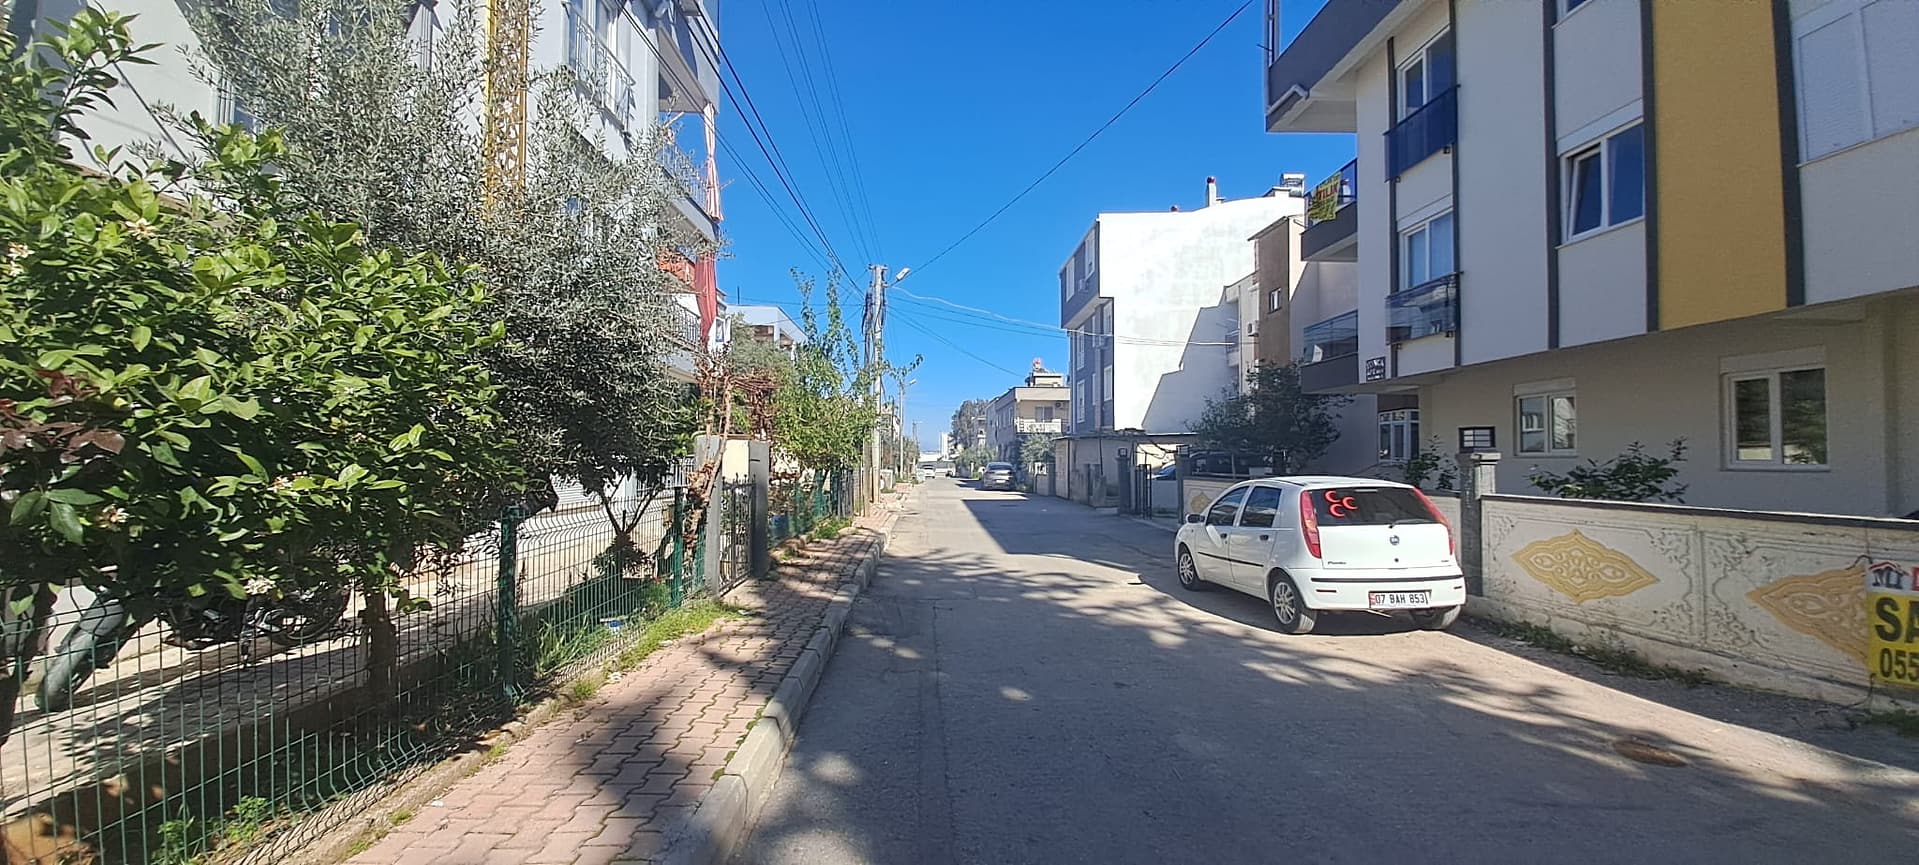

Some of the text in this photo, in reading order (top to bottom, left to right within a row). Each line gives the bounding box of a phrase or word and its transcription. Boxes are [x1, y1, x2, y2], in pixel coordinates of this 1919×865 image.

[1375, 593, 1425, 604] 07 BAH 853
